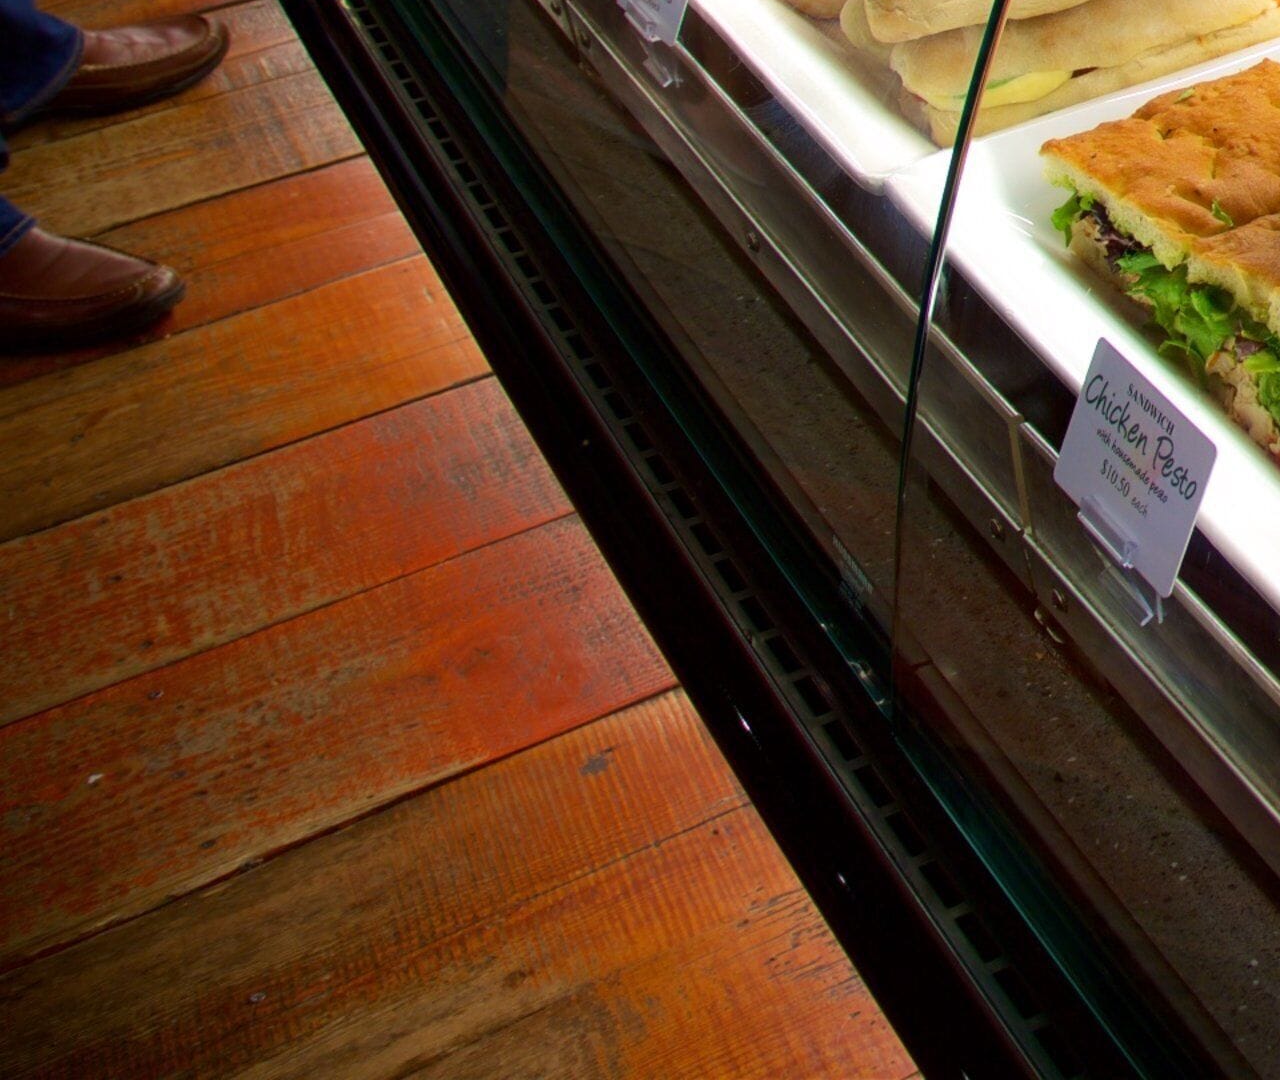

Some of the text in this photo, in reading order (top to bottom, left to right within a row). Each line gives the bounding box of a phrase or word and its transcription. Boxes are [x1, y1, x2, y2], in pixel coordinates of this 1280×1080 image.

[1086, 374, 1198, 501] Chicken Pesto
[1097, 428, 1111, 447] with
[1127, 382, 1175, 437] SANDWICH
[1100, 458, 1148, 519] $10.50 each
